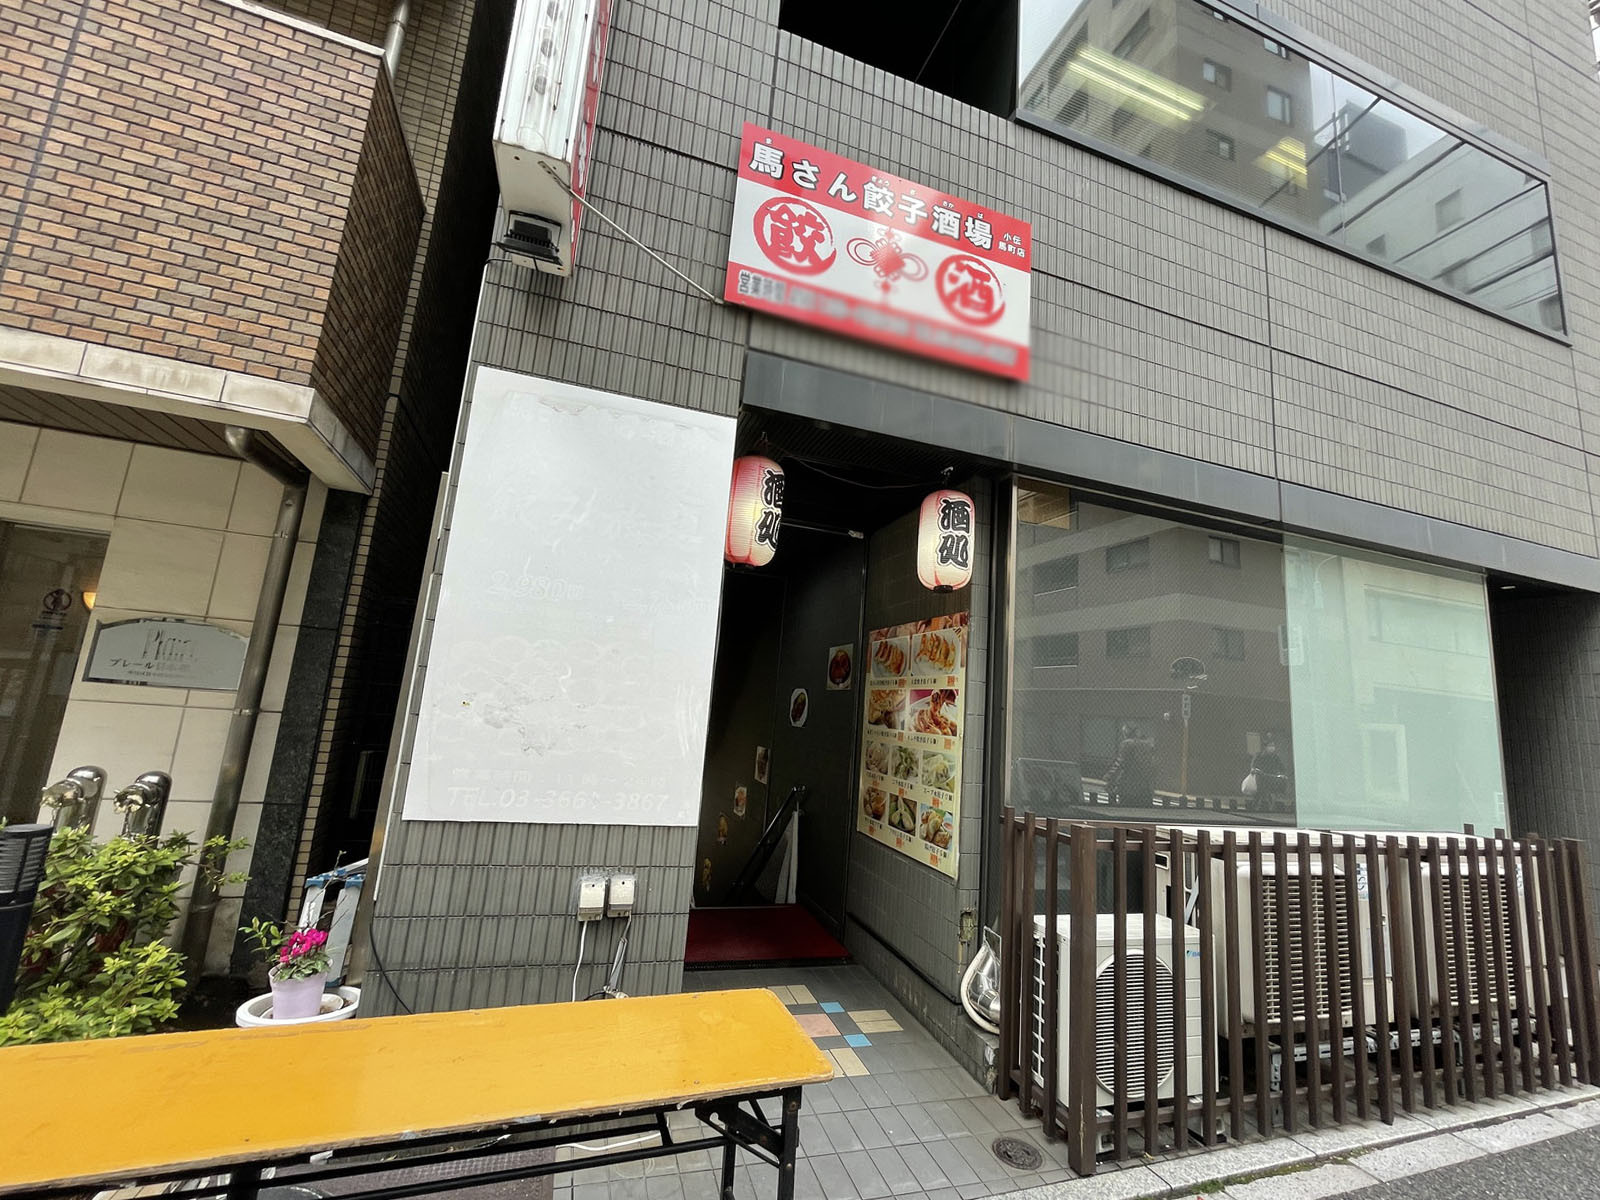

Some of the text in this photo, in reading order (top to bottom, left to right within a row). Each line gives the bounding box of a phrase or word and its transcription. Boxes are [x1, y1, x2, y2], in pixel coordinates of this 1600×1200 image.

[749, 142, 993, 251] 馬さん餃子酒場
[998, 241, 1026, 258] 馬町店
[1003, 232, 1022, 246] 小伝
[943, 257, 996, 317] 酒
[938, 498, 971, 569] 酒処
